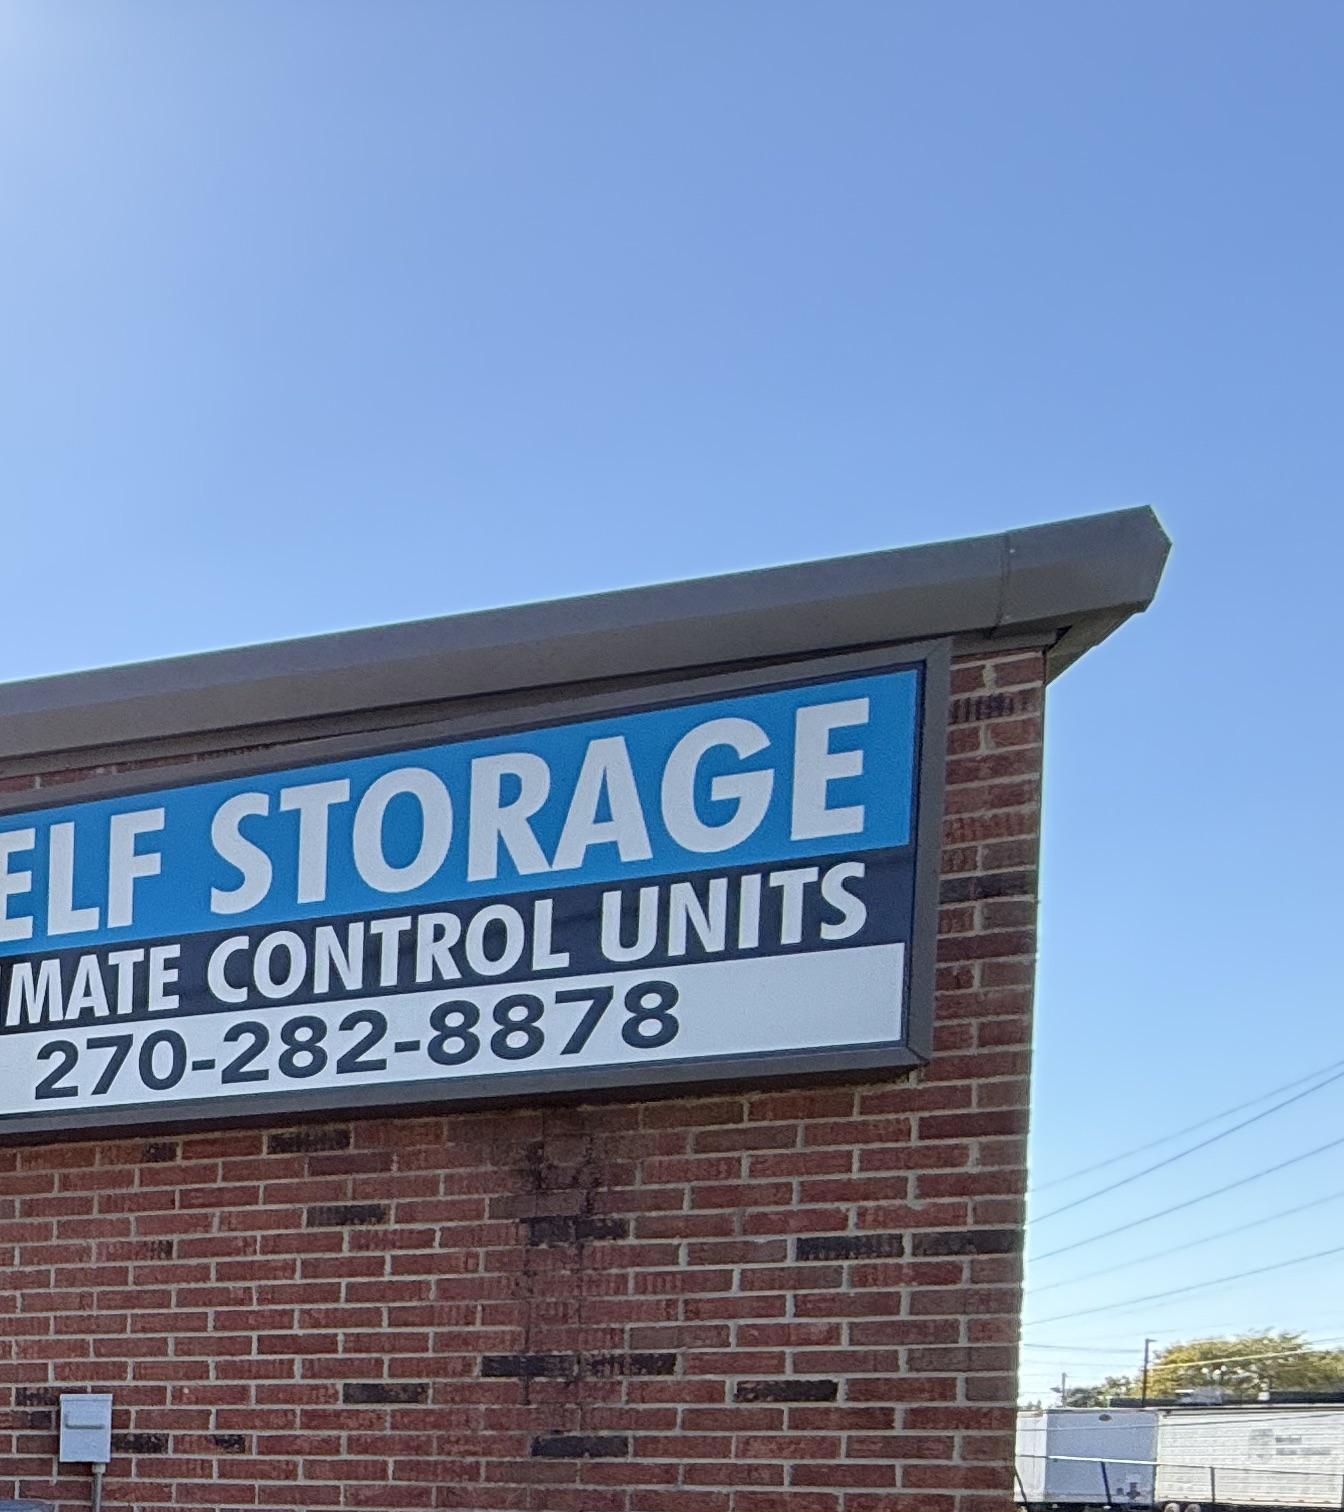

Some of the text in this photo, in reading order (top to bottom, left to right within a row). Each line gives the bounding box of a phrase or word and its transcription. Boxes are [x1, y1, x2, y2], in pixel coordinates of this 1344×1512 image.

[210, 697, 870, 915] STORAGE
[207, 898, 570, 1003] CONTROL
[601, 861, 868, 963] UNITS
[34, 980, 681, 1100] 270-282-8878
